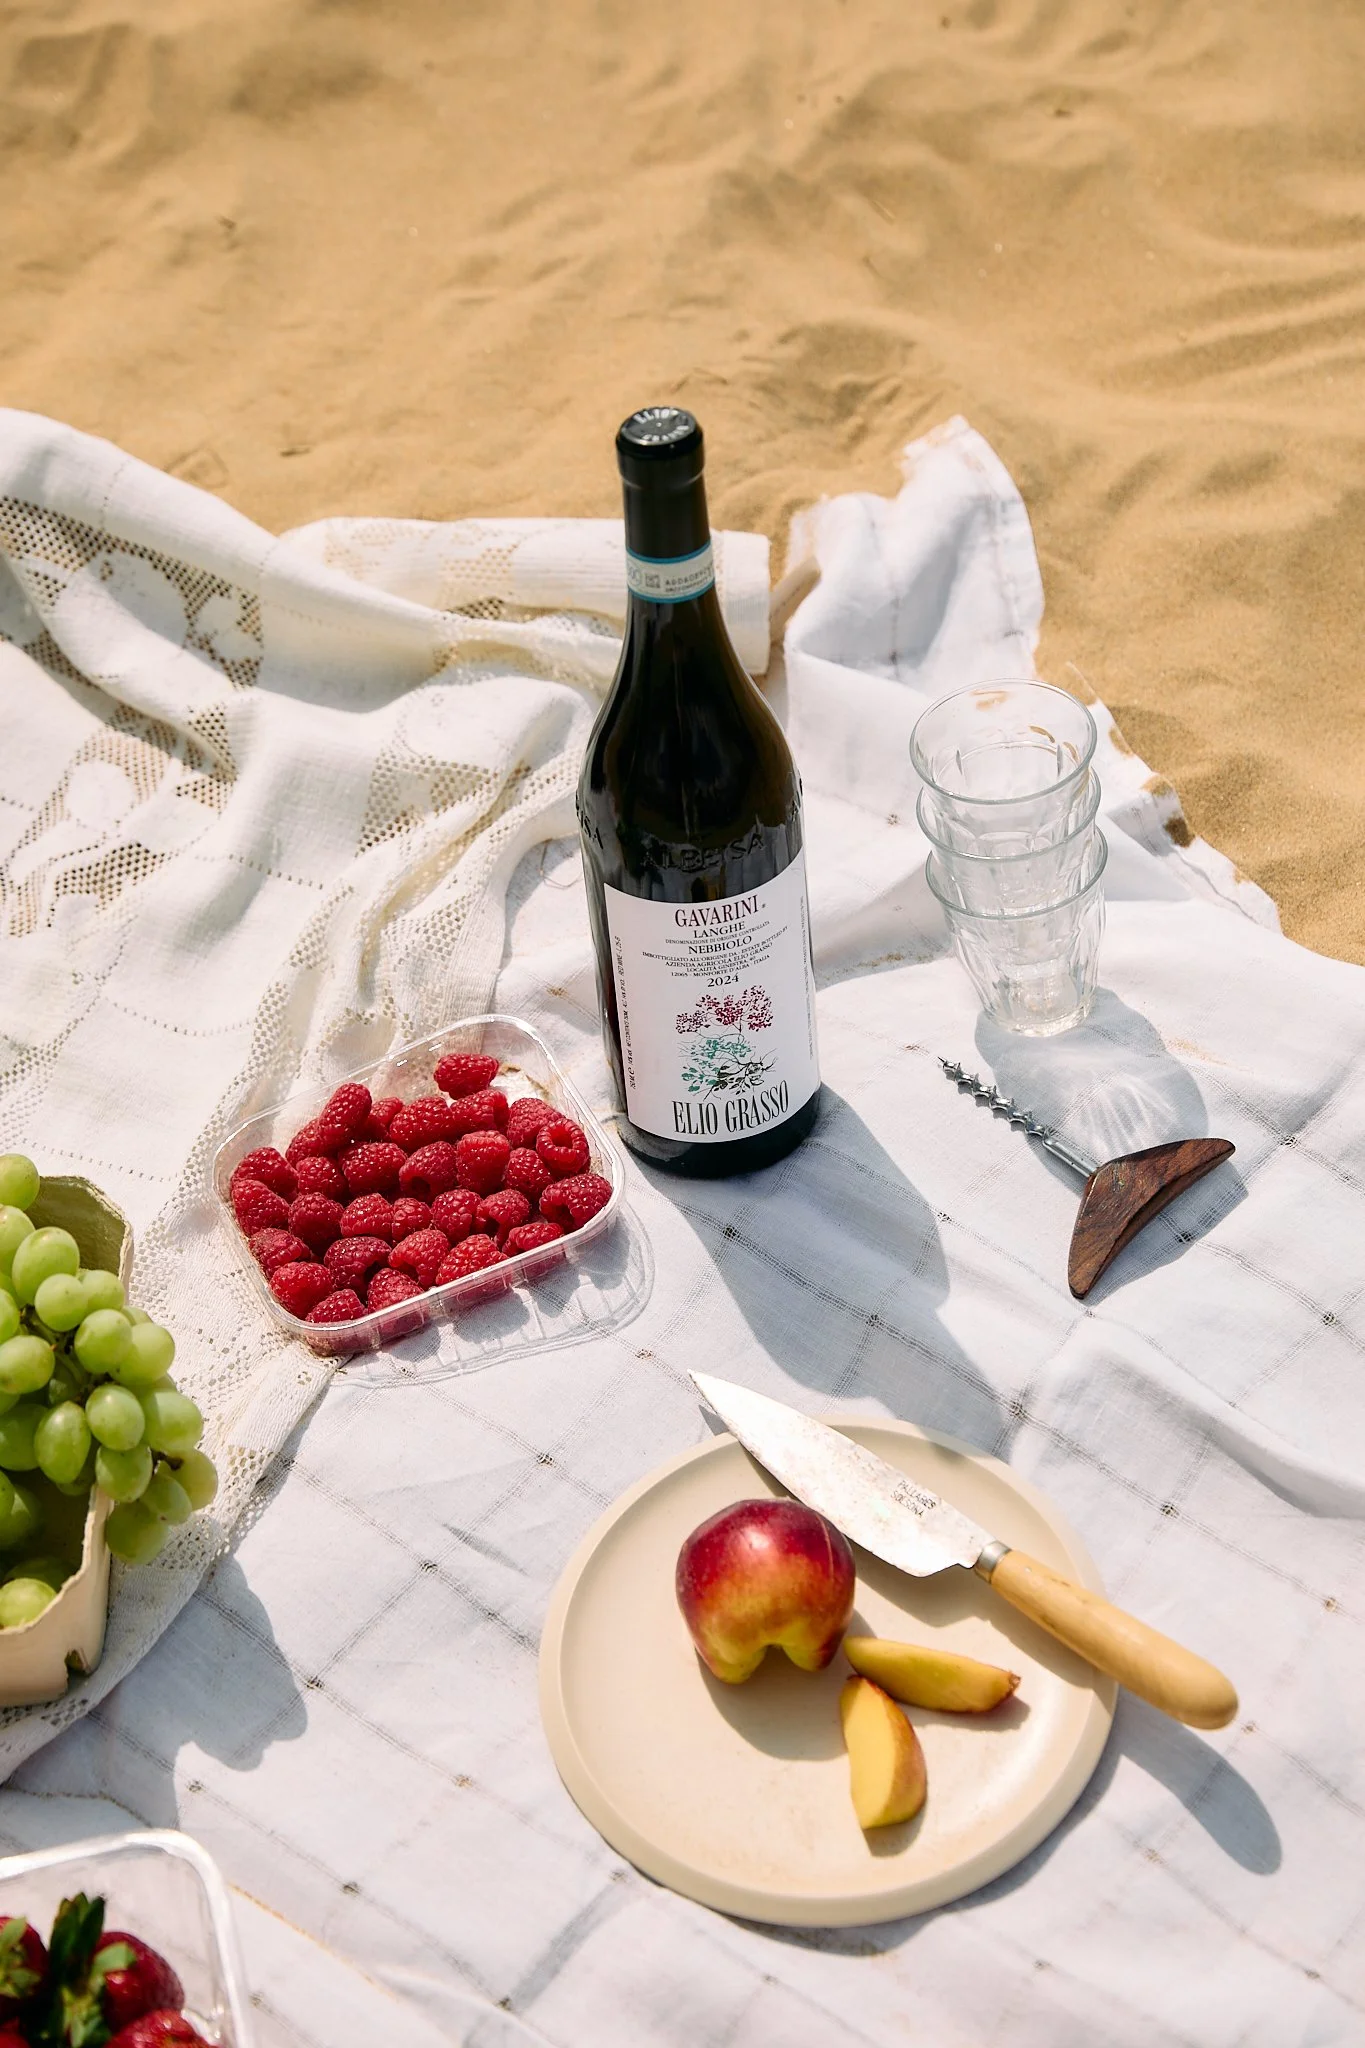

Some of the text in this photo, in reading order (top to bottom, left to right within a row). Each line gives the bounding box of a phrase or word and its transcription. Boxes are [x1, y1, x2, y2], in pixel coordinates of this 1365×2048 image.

[674, 894, 759, 928] GAVARINI
[693, 921, 746, 939] LANGHE
[716, 933, 738, 942] ORIGINE
[688, 935, 752, 955] NEBBIOLO
[696, 958, 732, 968] AGRICOLA
[733, 952, 749, 962] ELIO
[749, 942, 773, 956] GRASSO
[741, 943, 761, 954] ESTATE
[692, 968, 727, 977] MONFORTE
[753, 954, 770, 965] ITALIA
[707, 972, 739, 988] 2024
[672, 1079, 789, 1135] ELIO GRASSO
